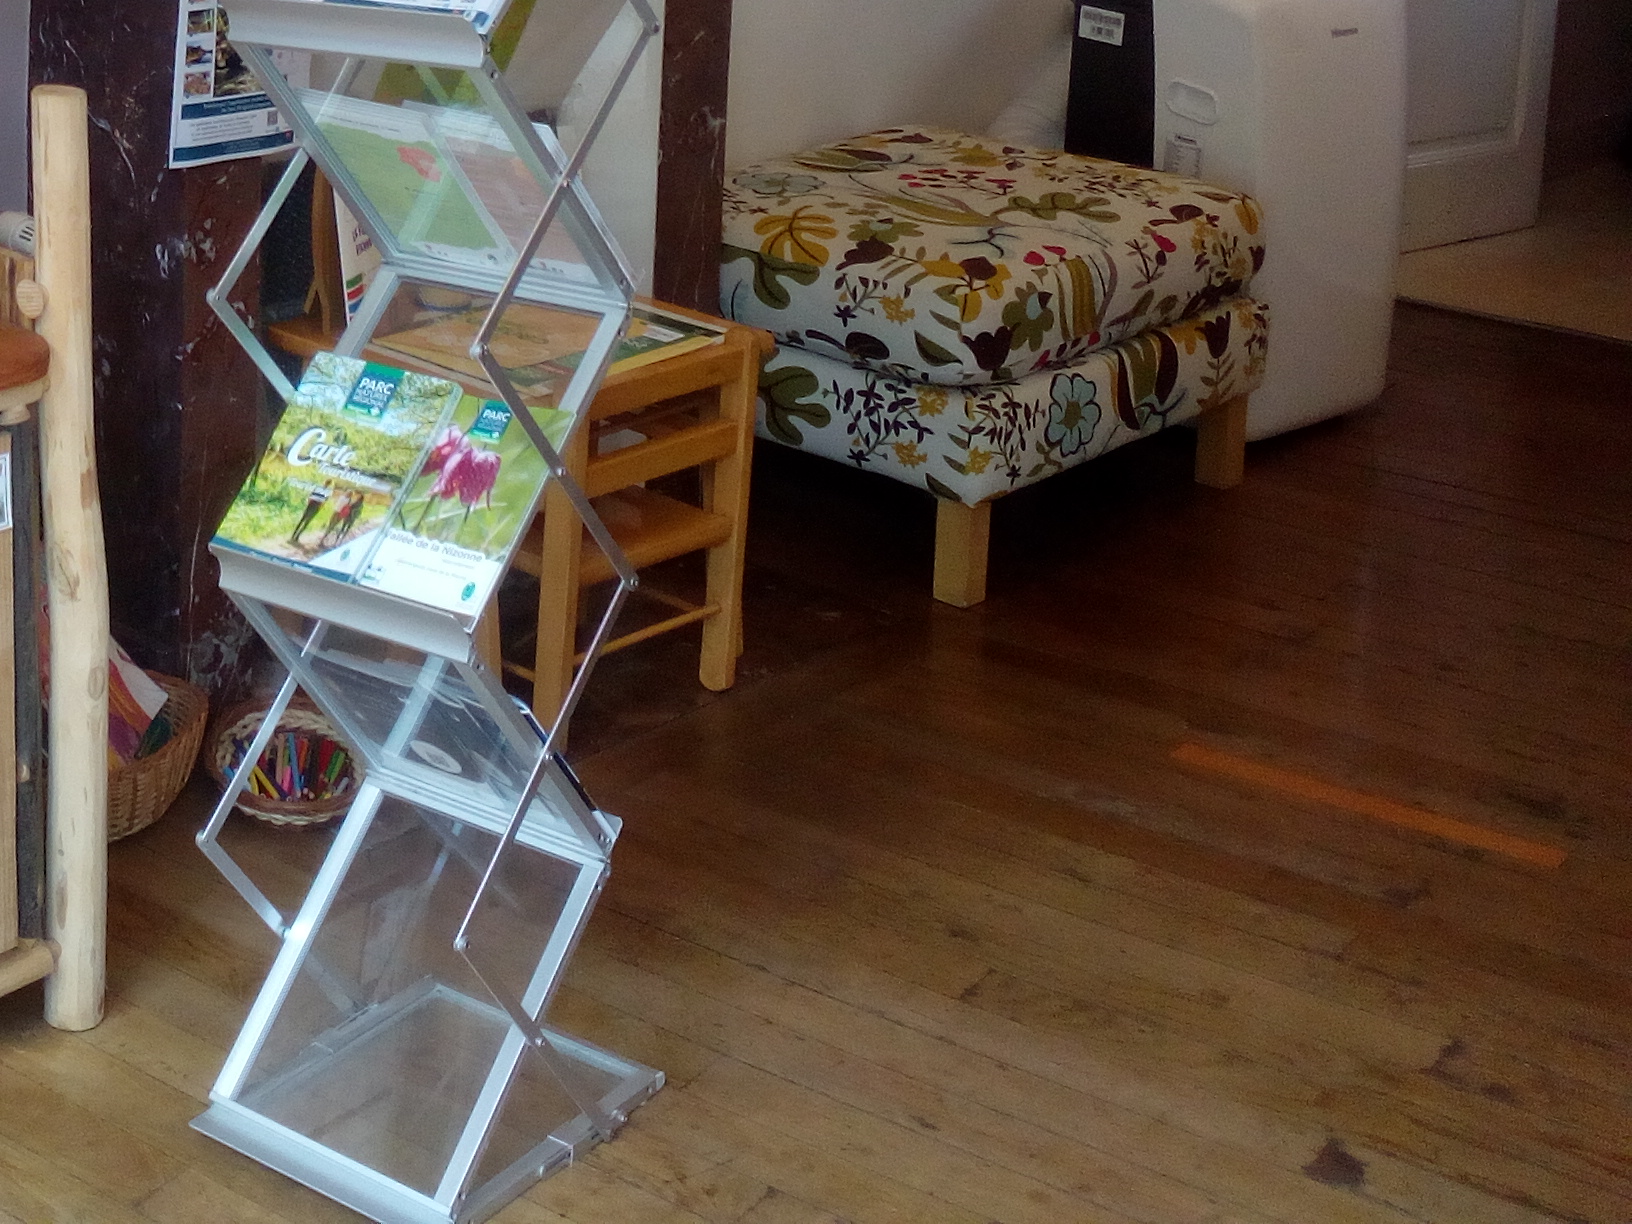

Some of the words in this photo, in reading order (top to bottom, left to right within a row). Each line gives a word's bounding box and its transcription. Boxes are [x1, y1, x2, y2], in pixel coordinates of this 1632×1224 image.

[359, 377, 394, 394] PARC
[482, 409, 511, 422] PARC
[288, 428, 355, 466] Carte
[416, 539, 429, 549] de
[442, 545, 483, 563] Nizonne
